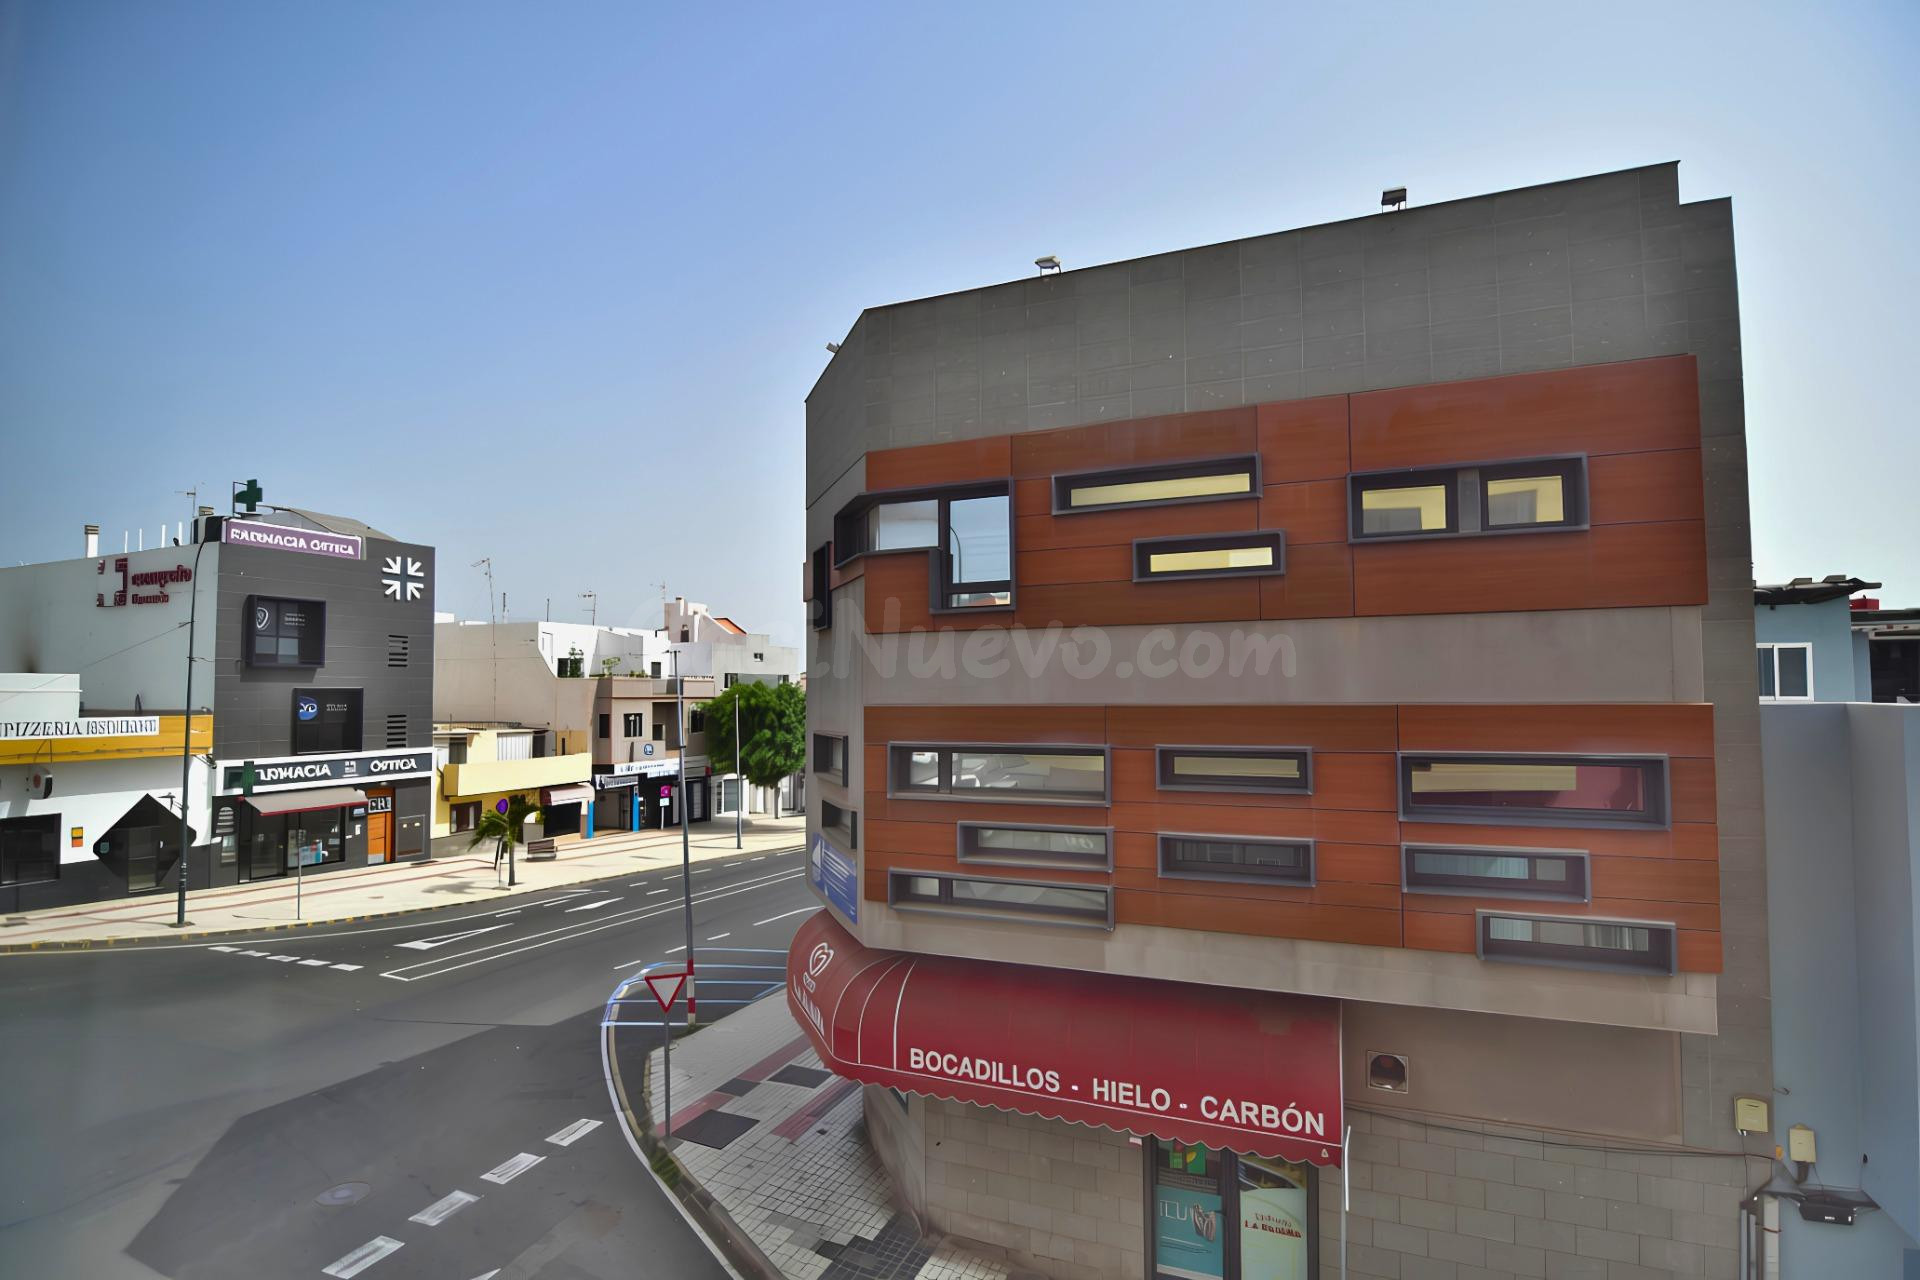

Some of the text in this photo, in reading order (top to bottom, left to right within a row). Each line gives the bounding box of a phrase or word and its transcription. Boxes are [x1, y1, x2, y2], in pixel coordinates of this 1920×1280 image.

[910, 1047, 1325, 1136] BOCADILLOS HIELO CARBÓN
